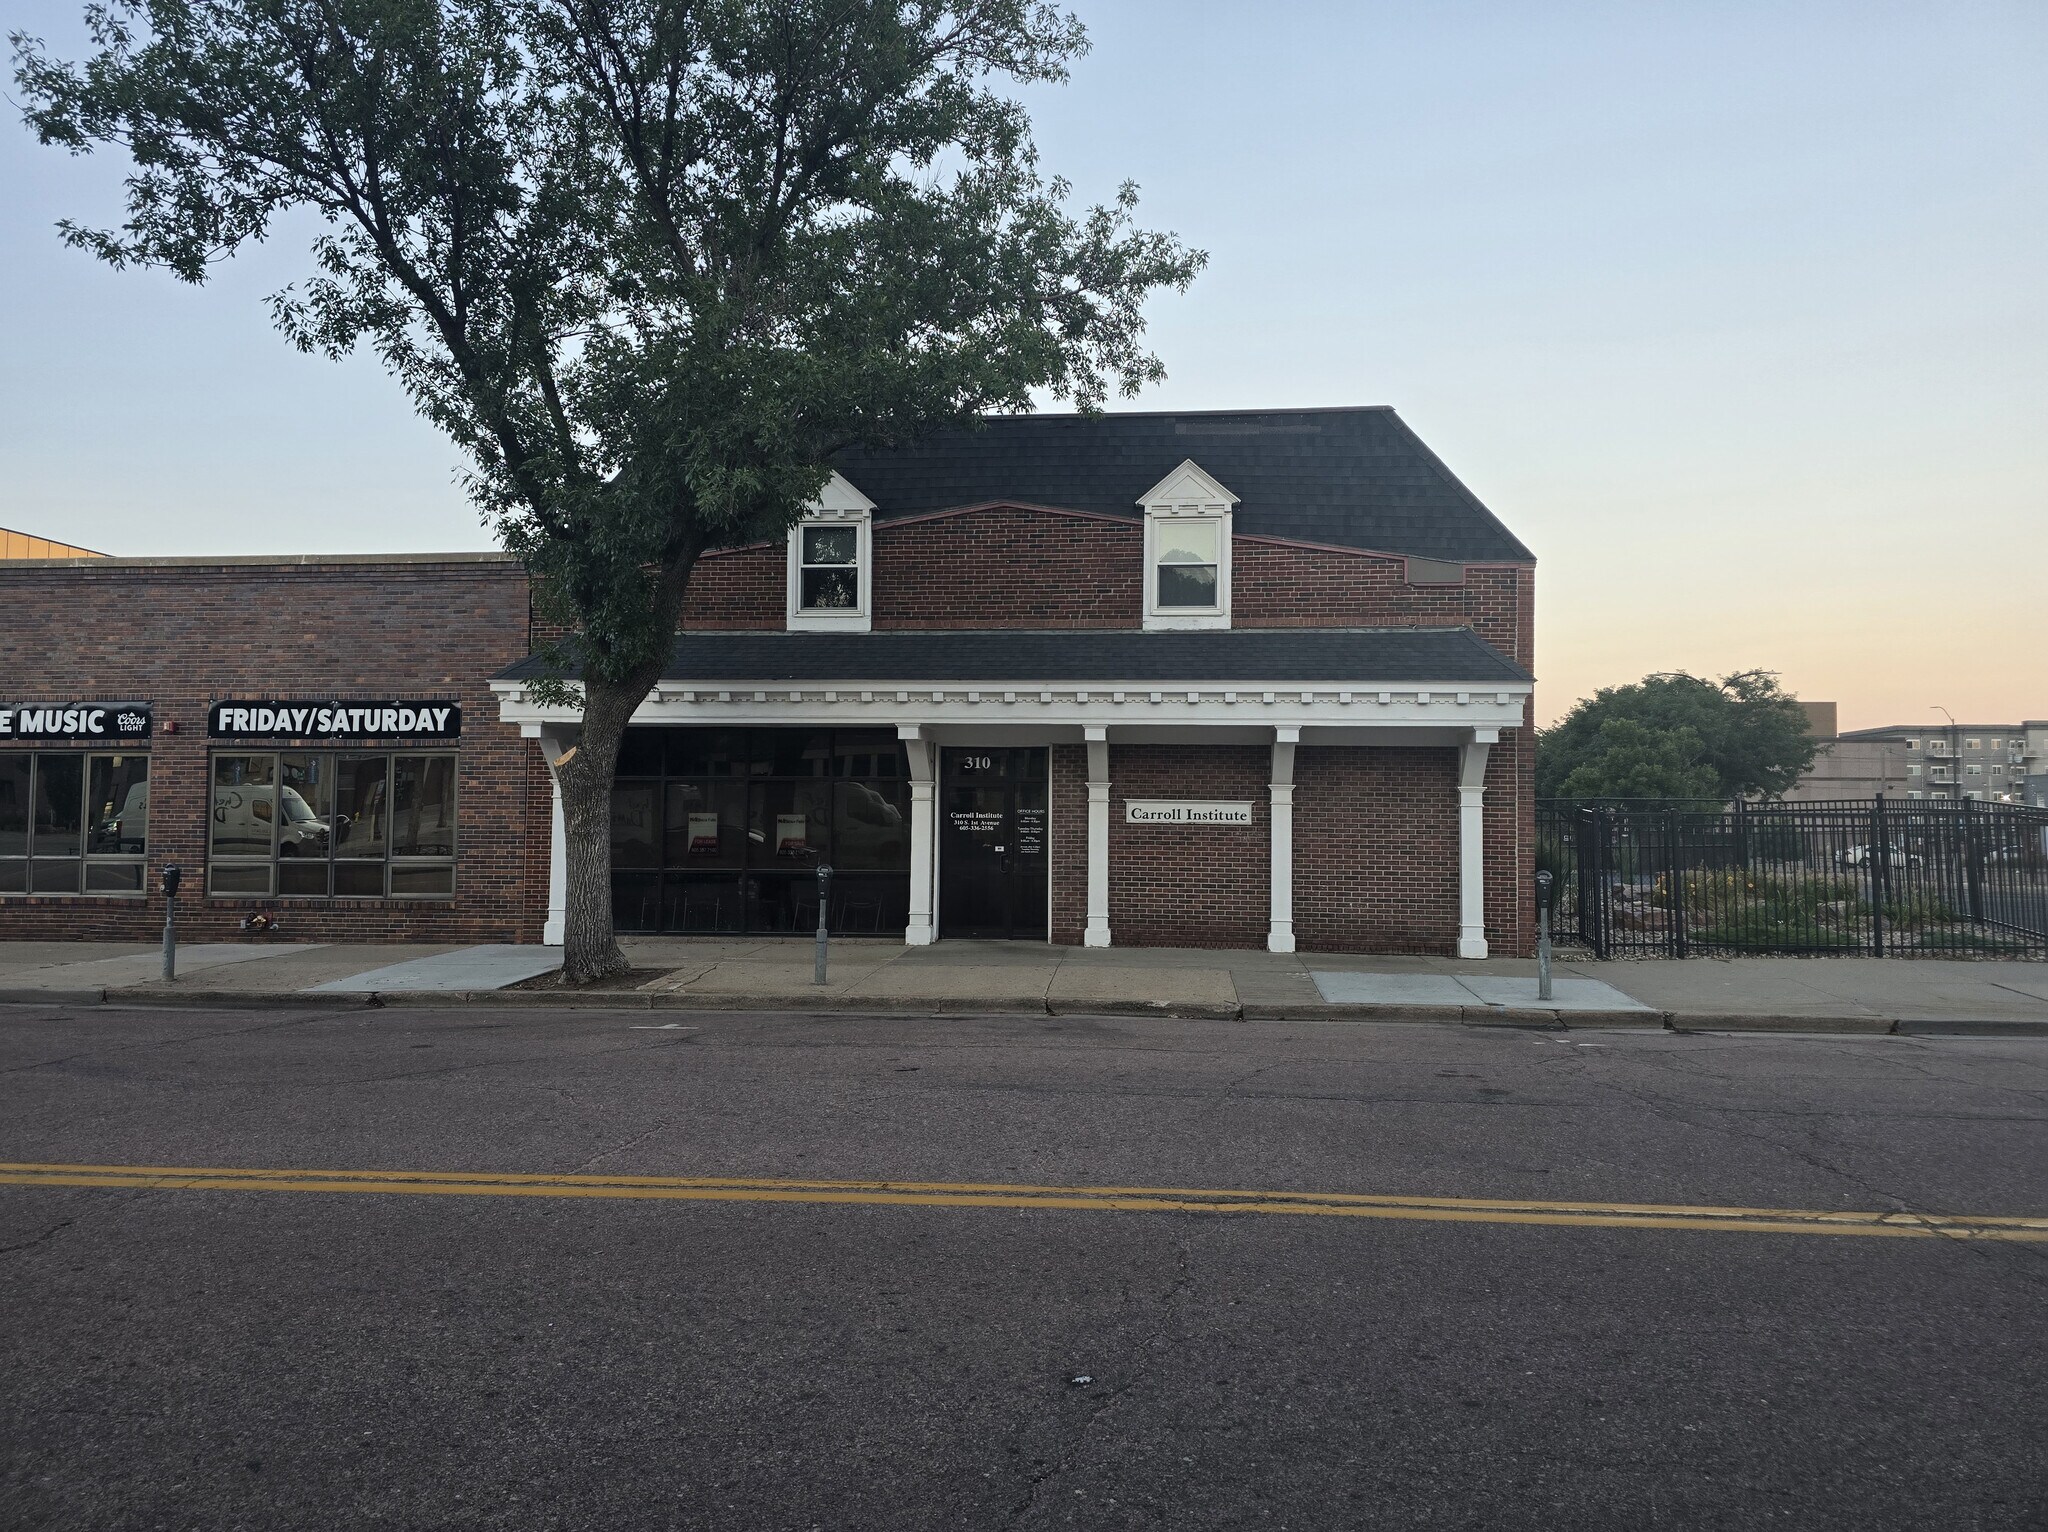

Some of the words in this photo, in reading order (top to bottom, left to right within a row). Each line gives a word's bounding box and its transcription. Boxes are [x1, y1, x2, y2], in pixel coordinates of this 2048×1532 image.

[20, 710, 105, 733] MUSIC
[117, 713, 147, 725] Coors
[218, 708, 451, 735] FRIDAY/SATURDAY
[964, 756, 991, 769] 310
[1131, 807, 1181, 820] Carroll
[1186, 808, 1248, 821] Institute
